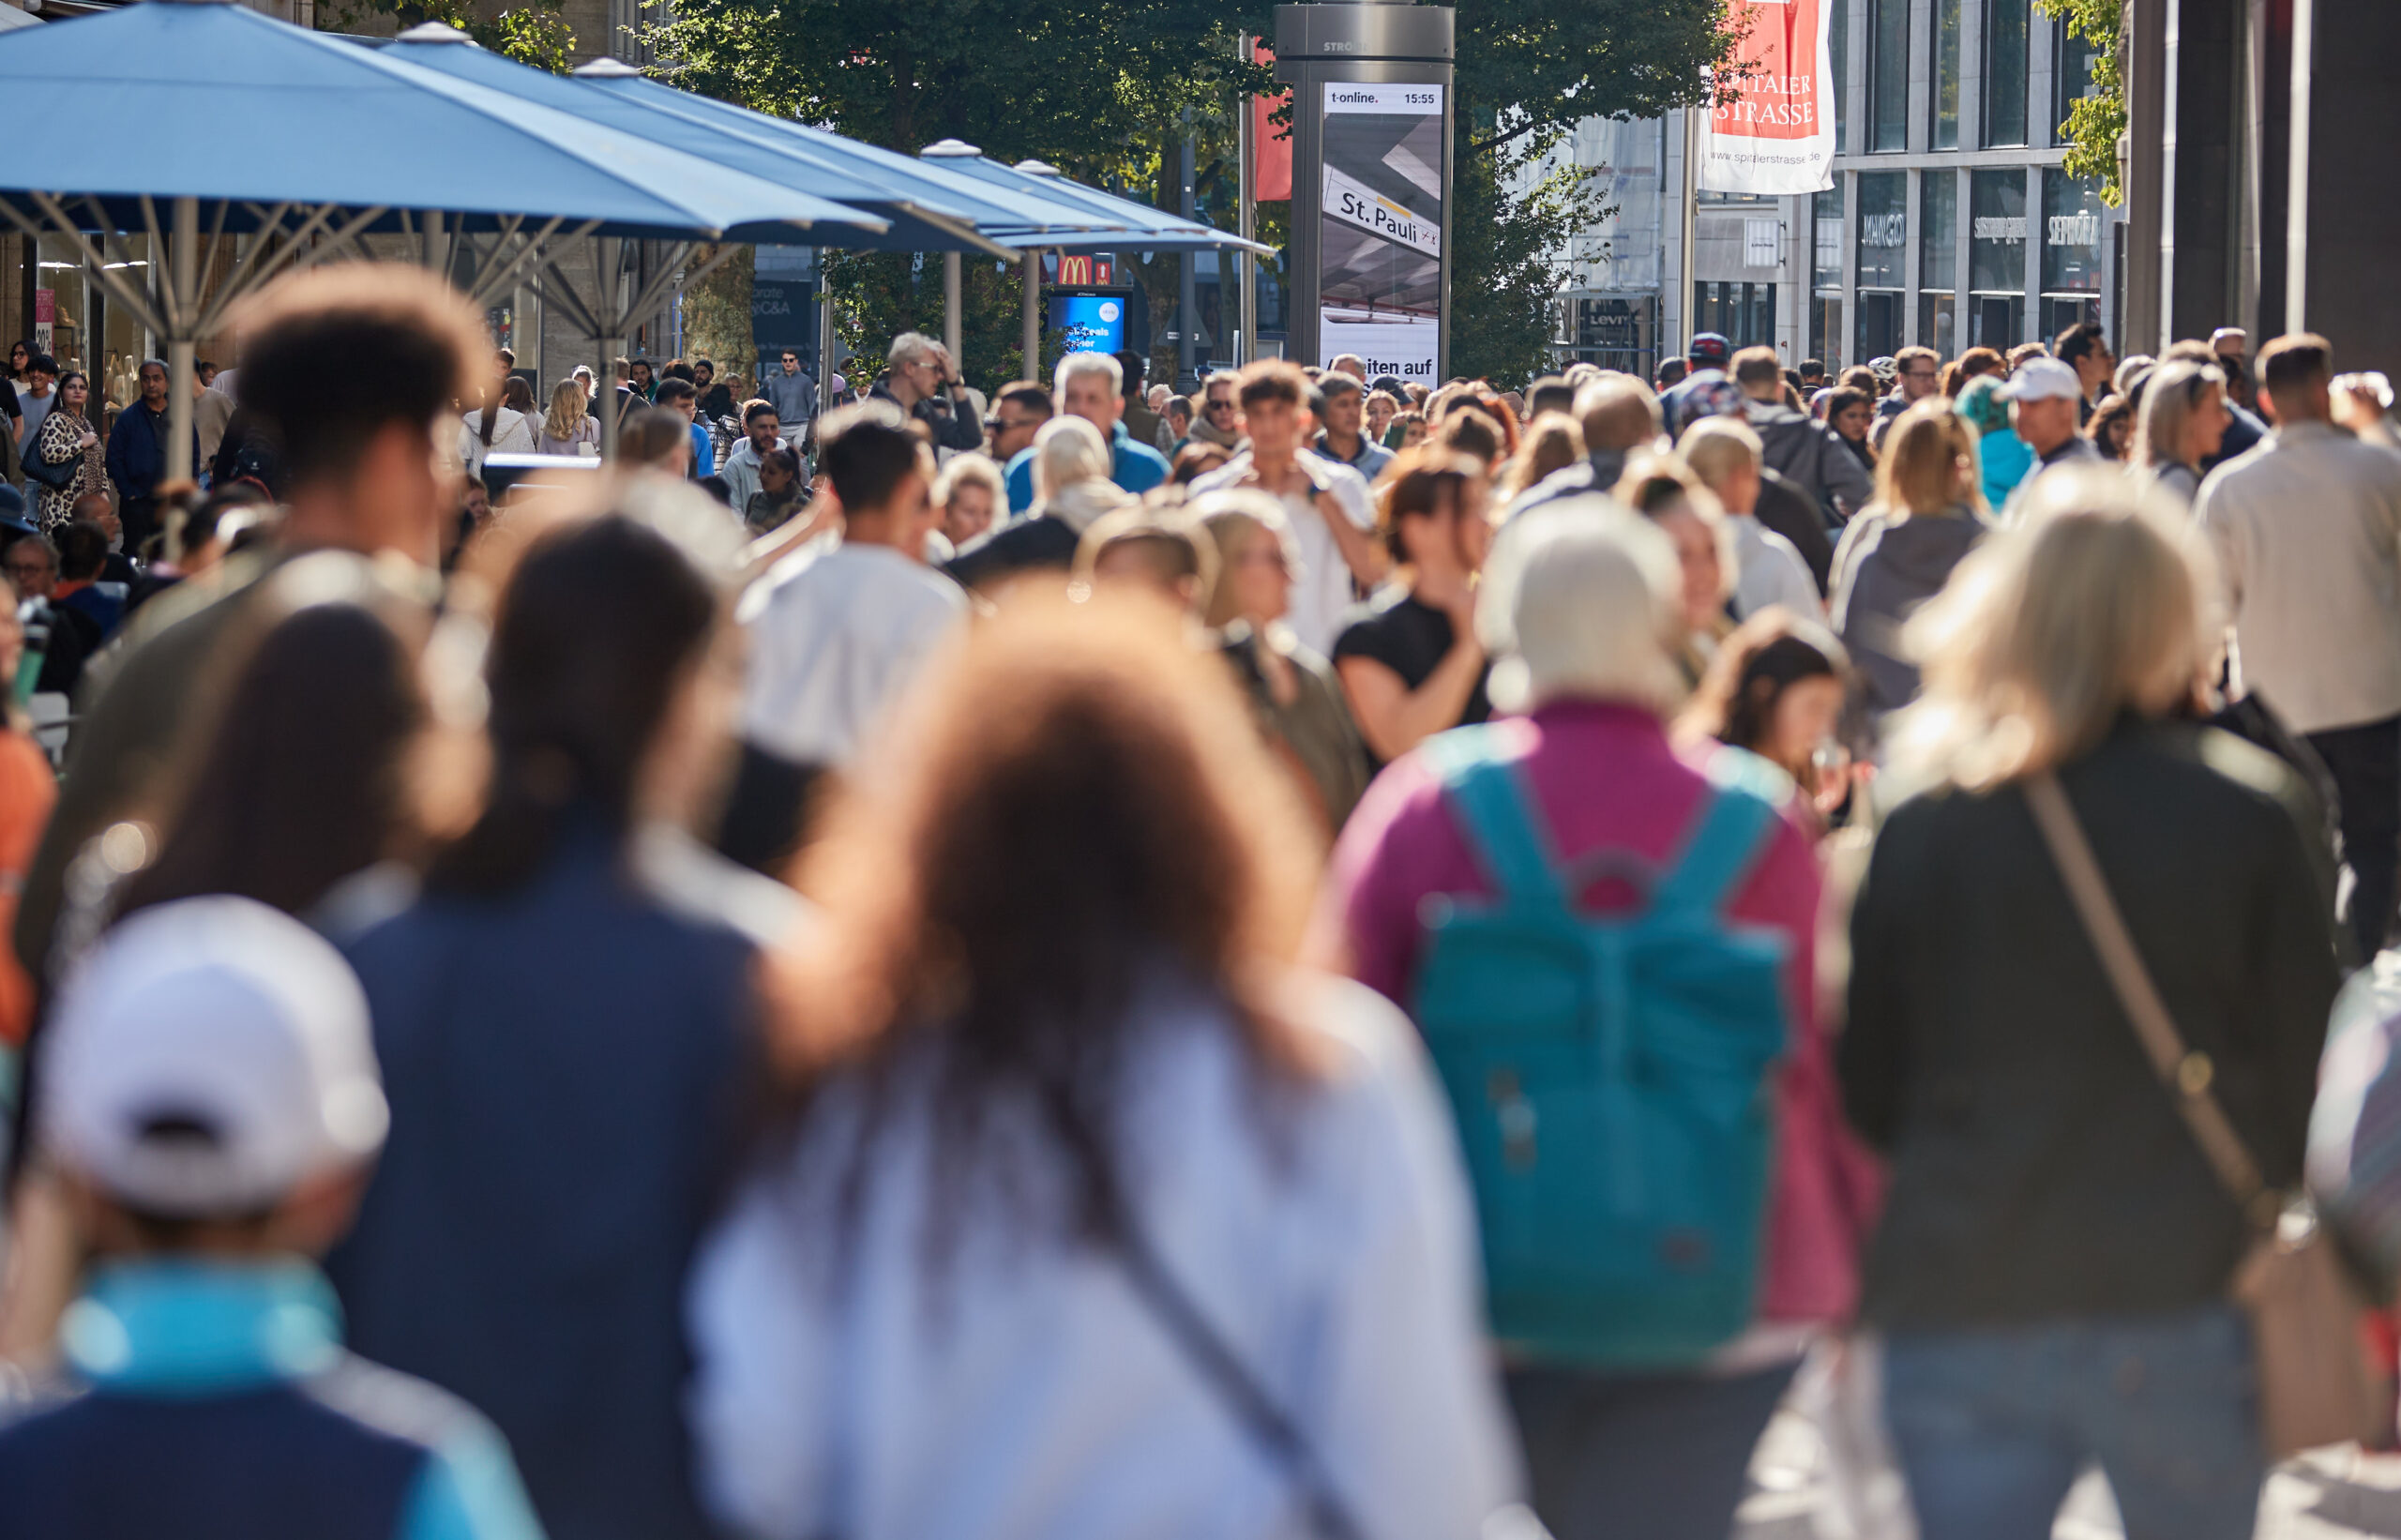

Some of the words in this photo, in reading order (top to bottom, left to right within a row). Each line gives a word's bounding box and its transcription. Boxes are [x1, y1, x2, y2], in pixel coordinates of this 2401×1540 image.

[1332, 92, 1379, 103] t-online.
[1405, 94, 1435, 104] 15:55
[1716, 101, 1813, 126] STRASSE
[1710, 151, 1820, 165] www.spilerstrassede
[1340, 192, 1370, 223] St.
[1375, 207, 1417, 243] Pauli
[1864, 214, 1905, 248] MANGO
[37, 329, 52, 352] 20%
[1404, 359, 1432, 374] auf
